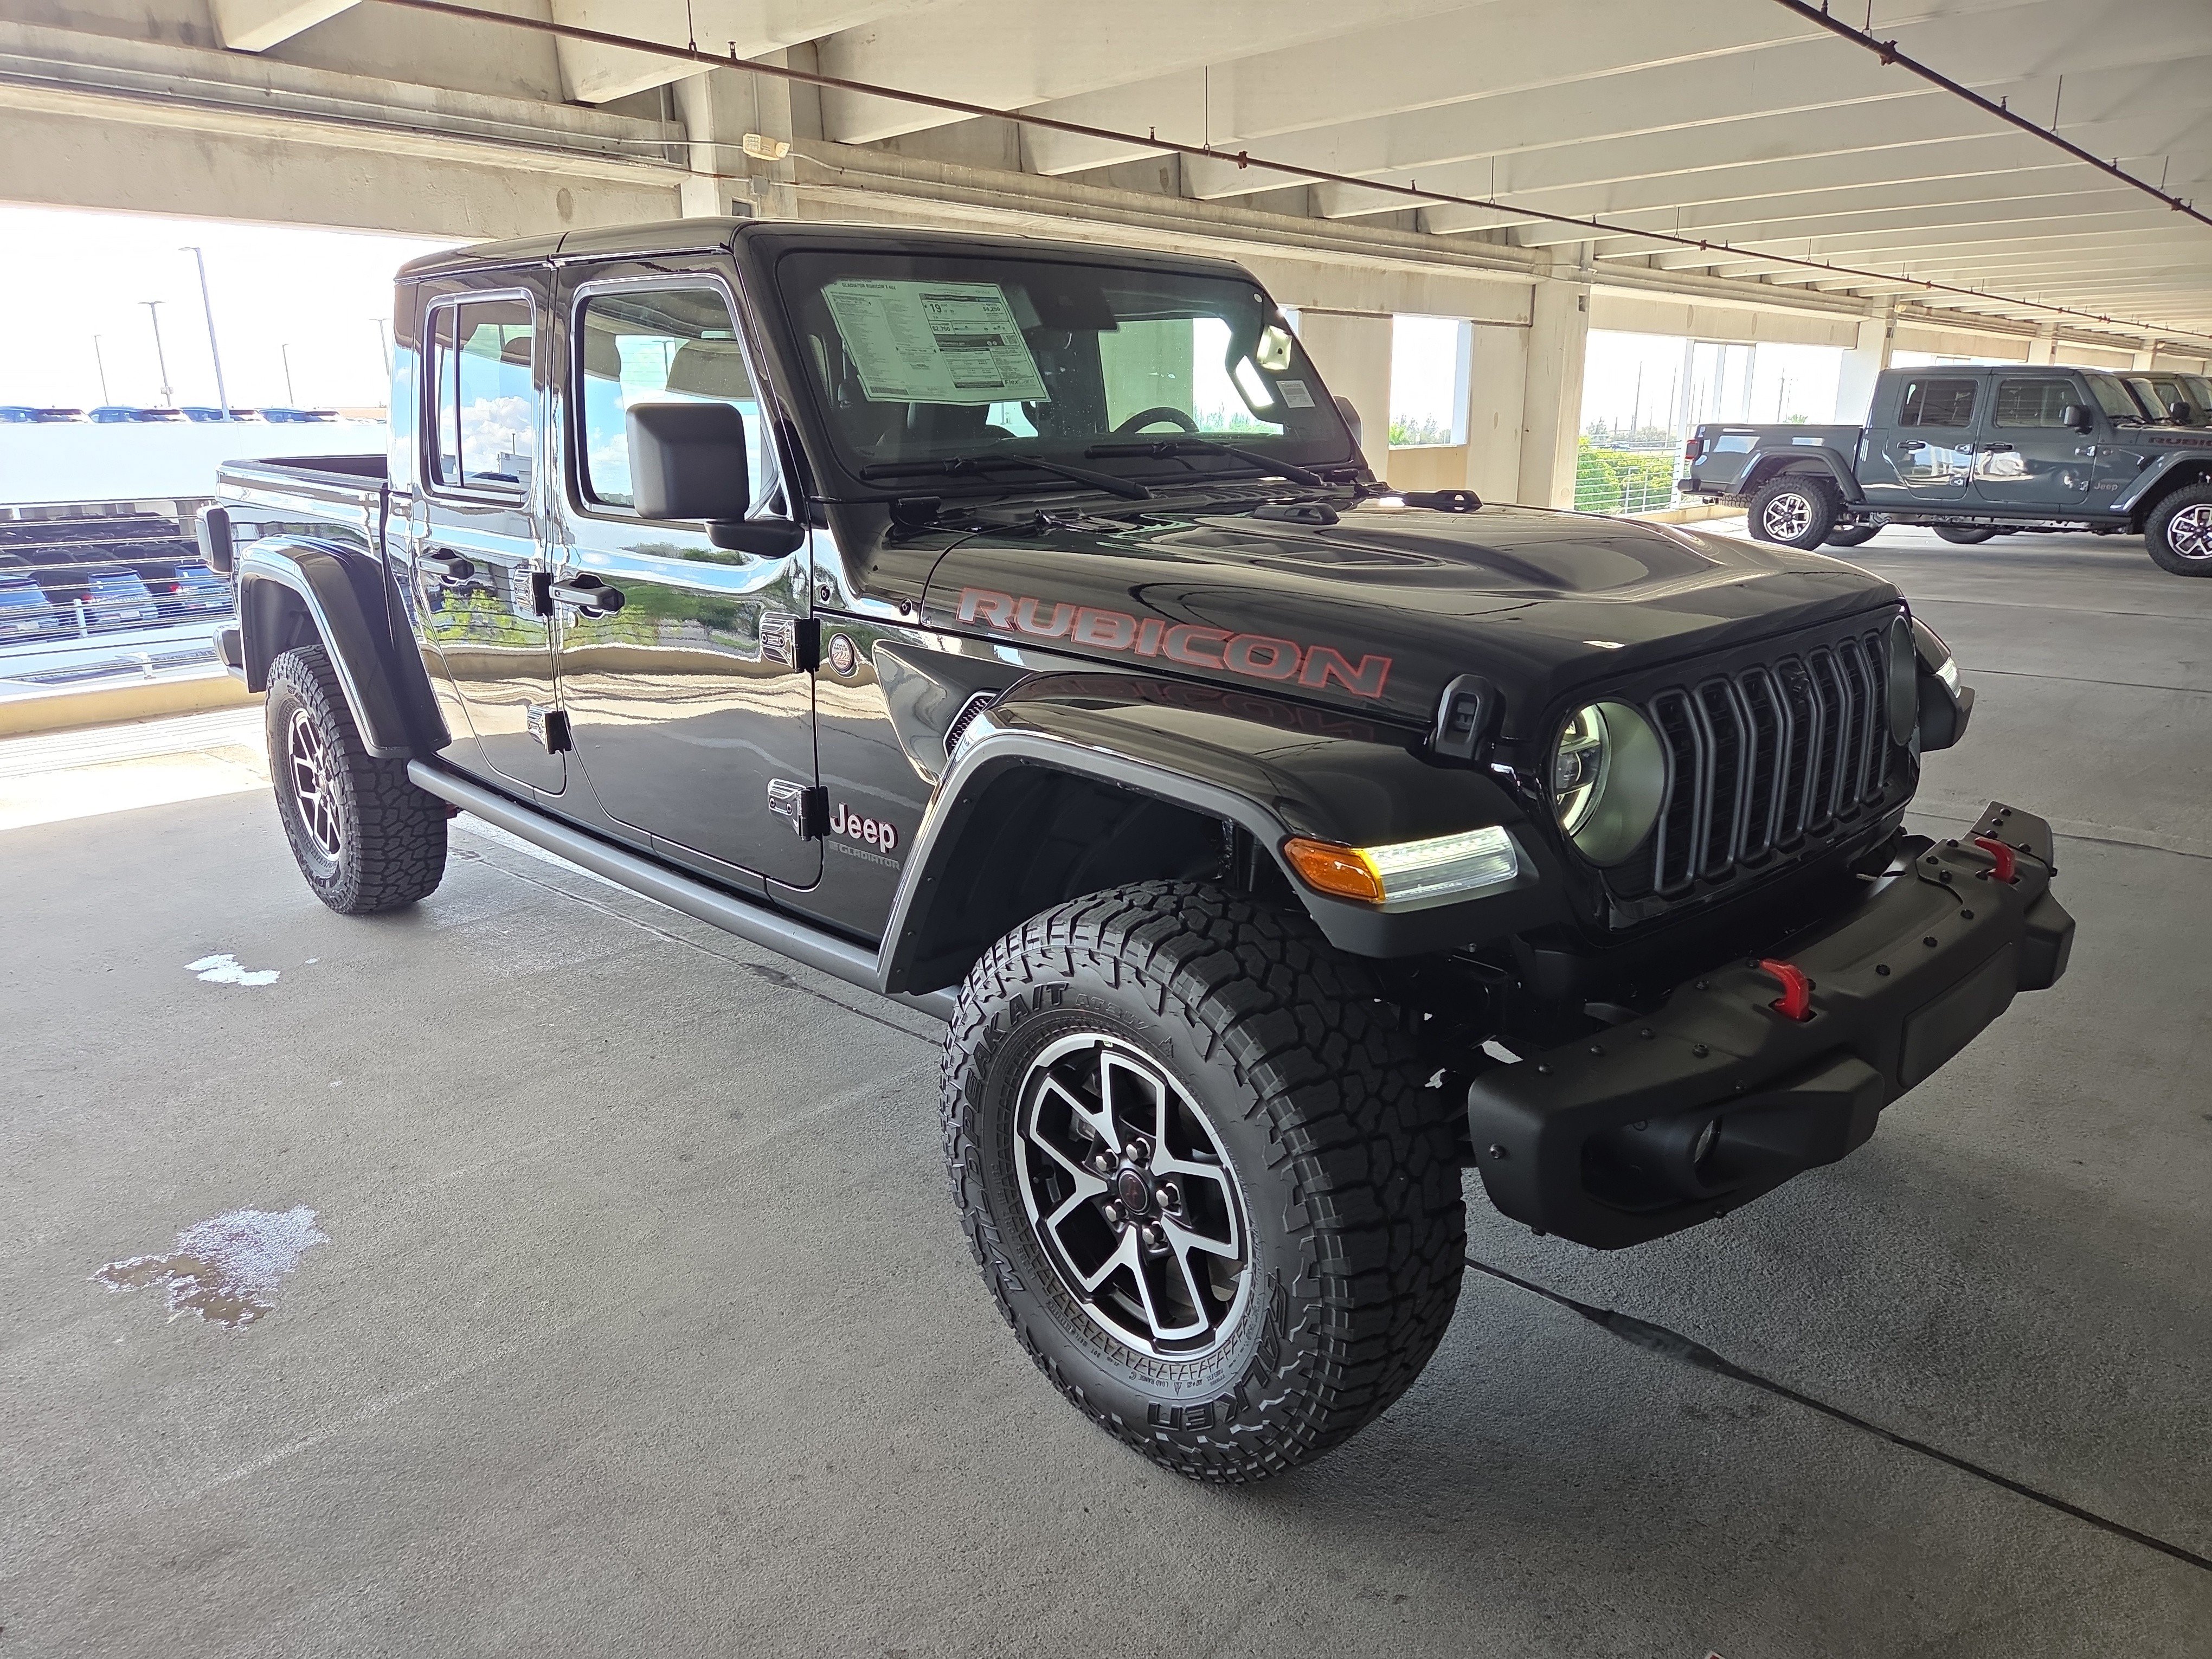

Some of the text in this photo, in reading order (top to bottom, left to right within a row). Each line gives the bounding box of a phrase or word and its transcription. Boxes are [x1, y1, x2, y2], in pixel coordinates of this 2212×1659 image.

[929, 303, 942, 313] 19
[2094, 481, 2118, 491] Jeep
[956, 587, 1392, 698] RUBICON
[829, 802, 898, 853] Jeep
[839, 845, 900, 871] GLADIATOR
[963, 1011, 1025, 1292] WILDPEAK
[1147, 1266, 1287, 1431] FALKEN
[1128, 1371, 1137, 1380] C
[1156, 1379, 1168, 1388] LOAD
